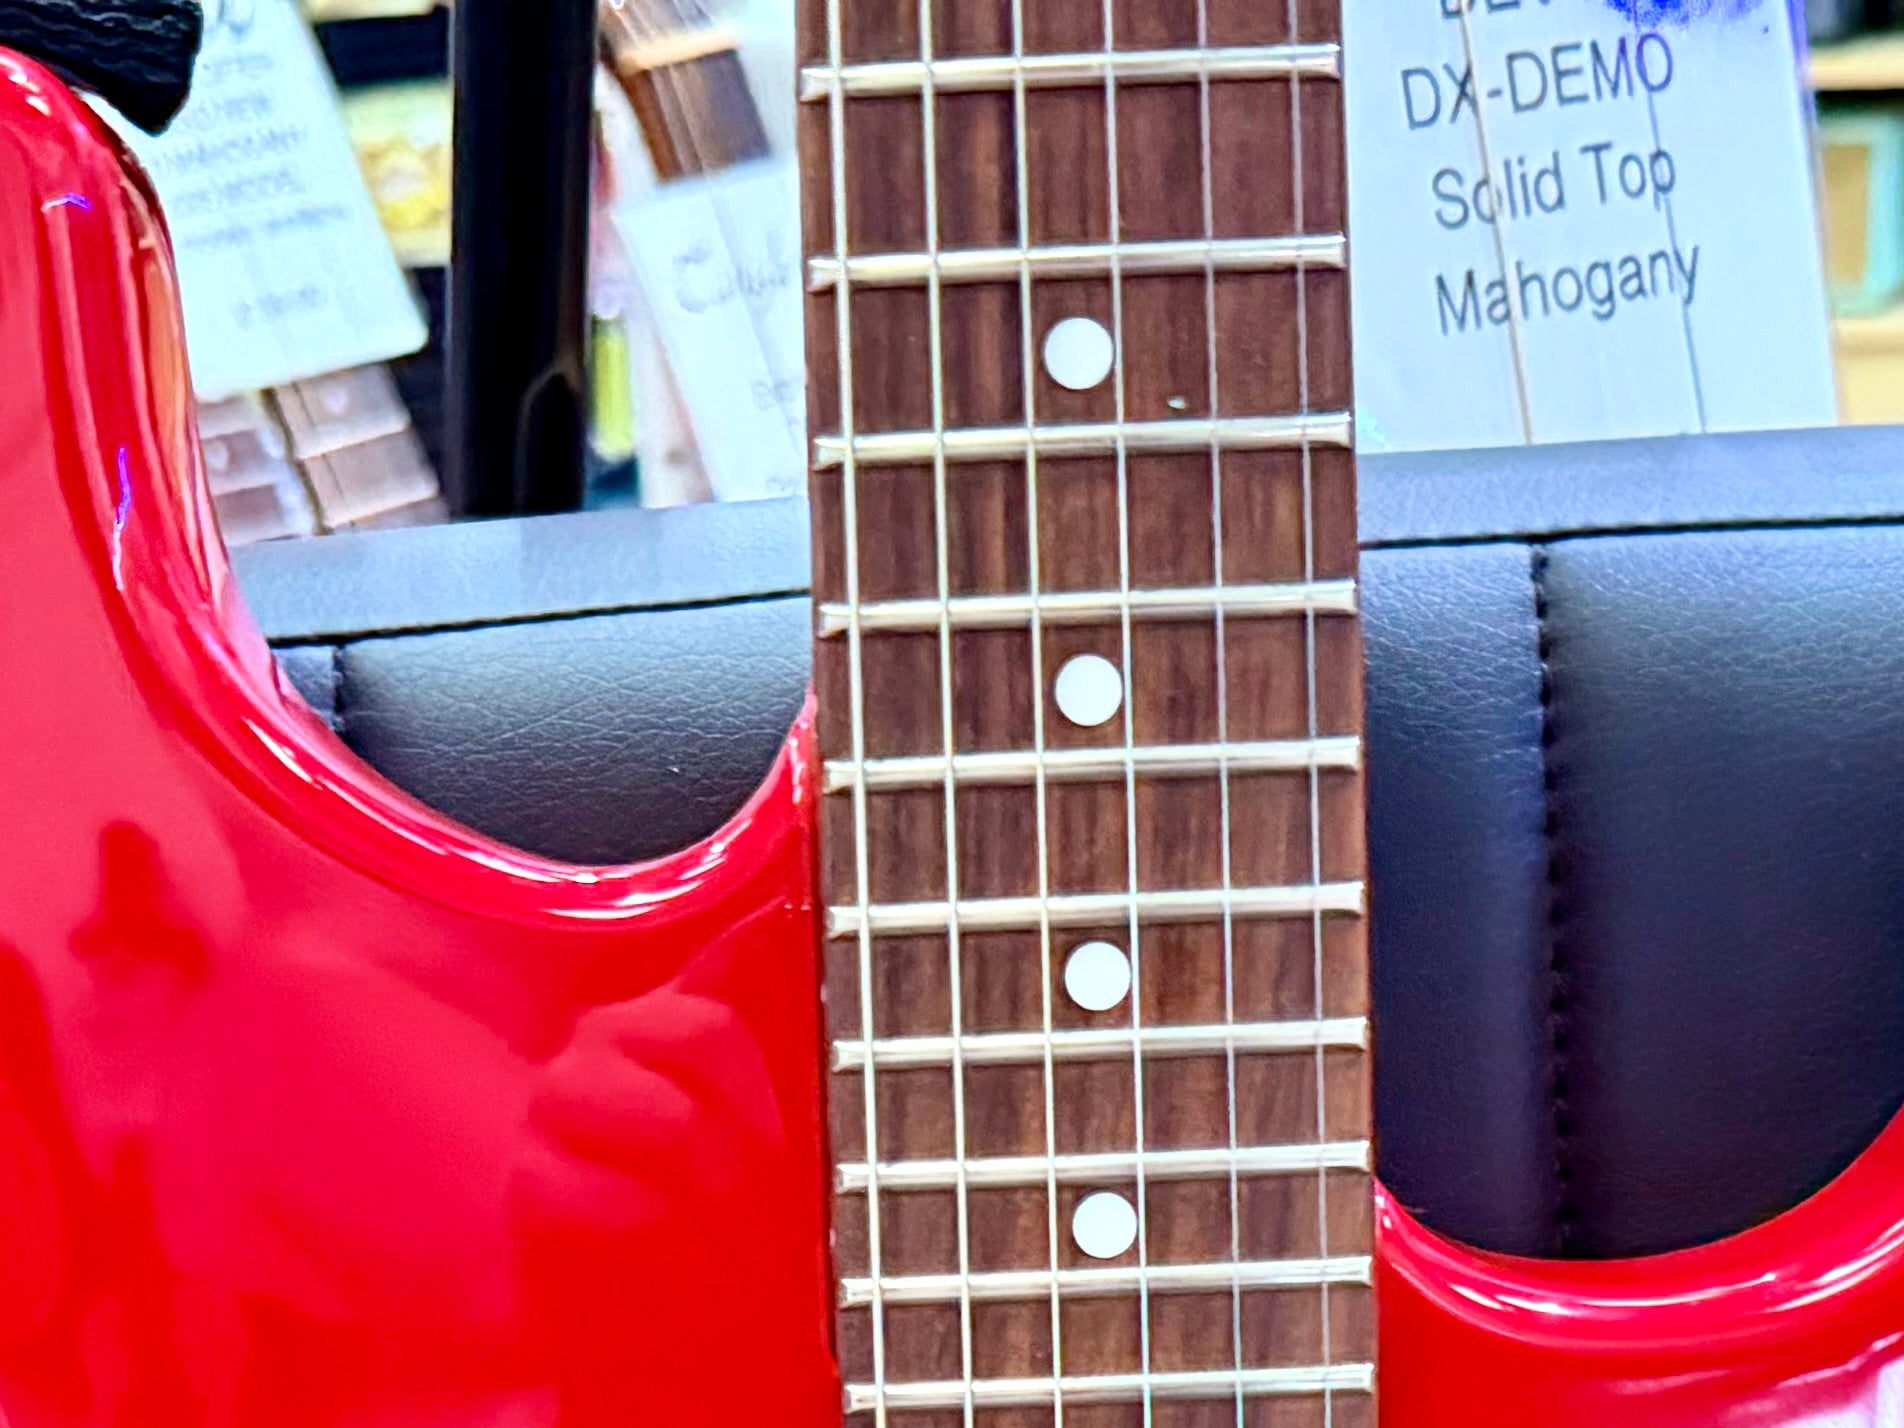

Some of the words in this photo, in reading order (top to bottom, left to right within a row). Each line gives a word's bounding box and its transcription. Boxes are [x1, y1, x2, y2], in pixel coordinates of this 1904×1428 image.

[1400, 32, 1675, 130] DX-DEMO
[1431, 150, 1567, 231] Solid
[1578, 140, 1677, 213] Top
[1434, 244, 1701, 337] Mahogany
